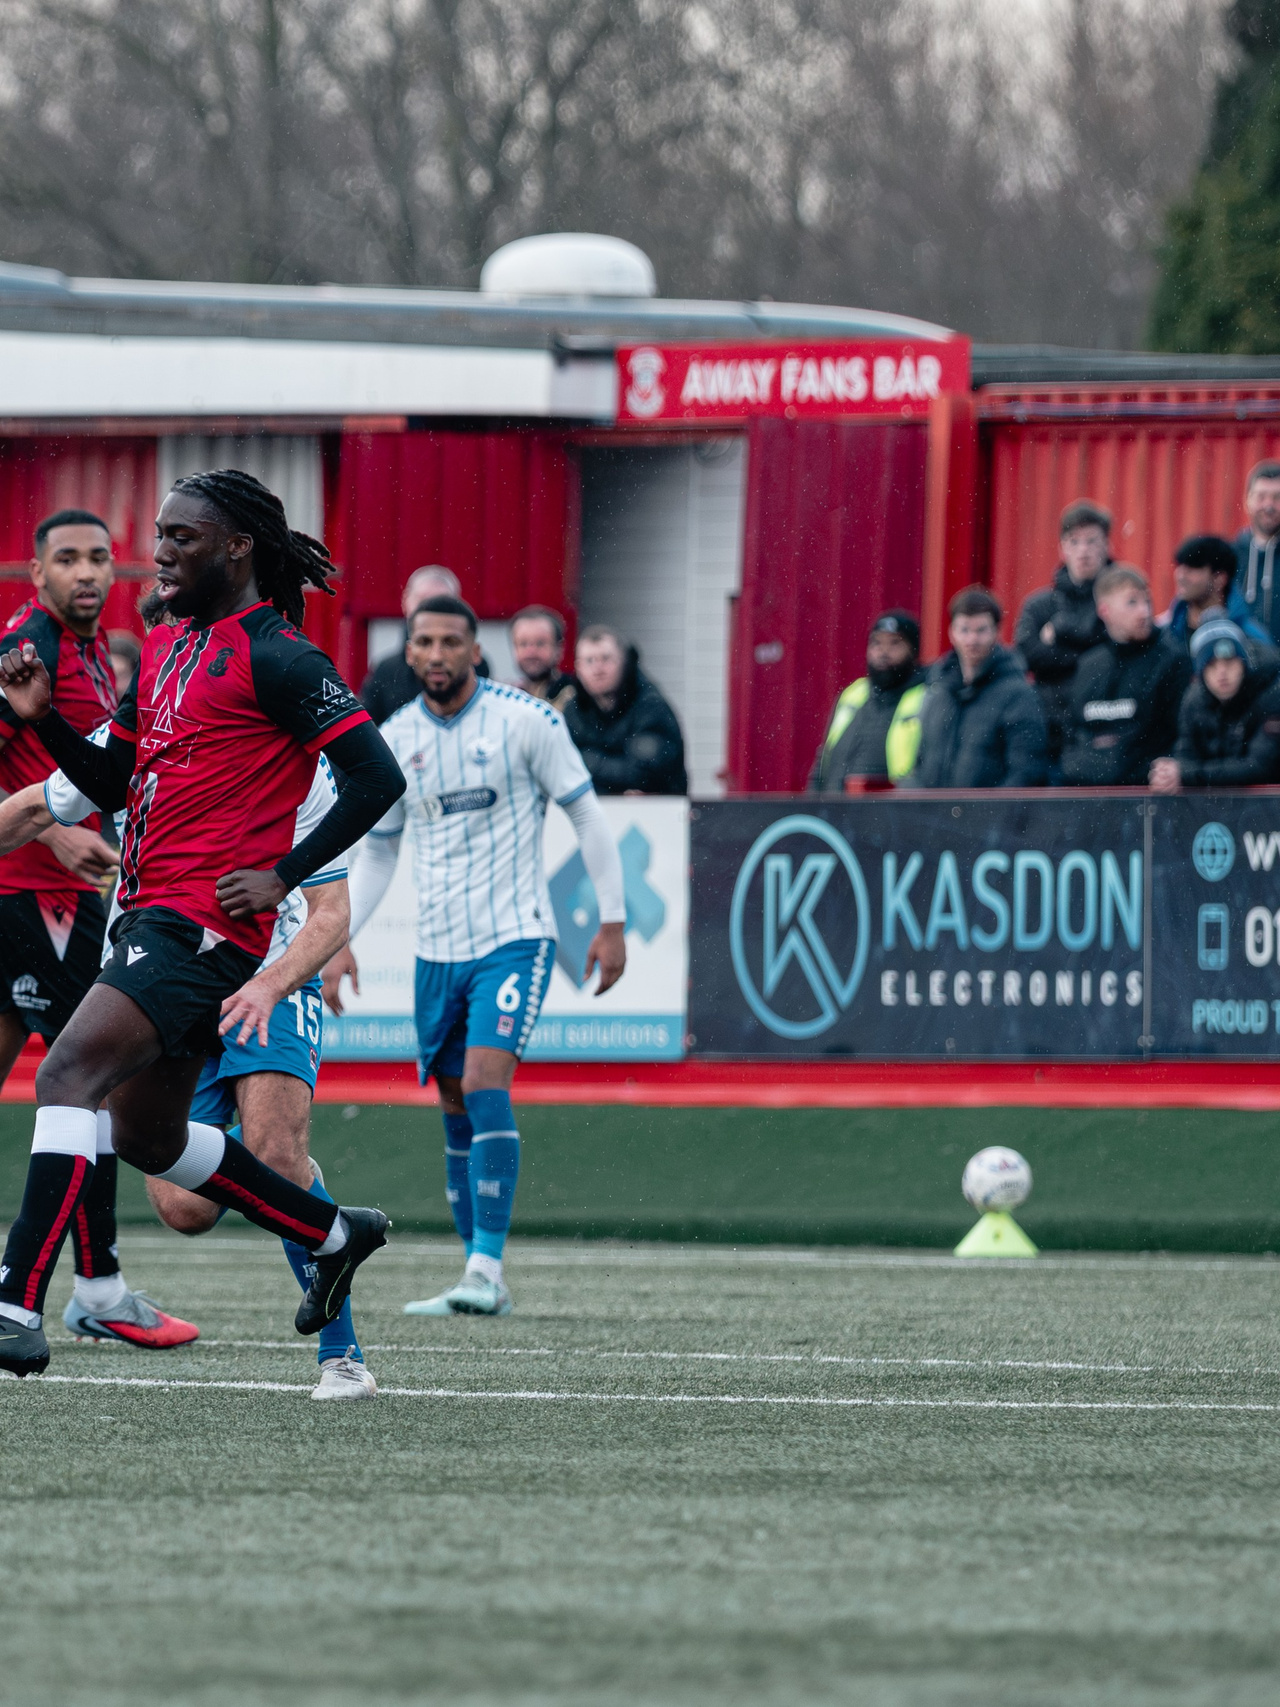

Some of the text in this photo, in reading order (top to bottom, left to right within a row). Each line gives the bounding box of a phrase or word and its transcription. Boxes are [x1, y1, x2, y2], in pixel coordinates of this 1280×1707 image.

[680, 354, 942, 404] AWAY FANS BAR
[882, 850, 1144, 952] KASDON
[496, 972, 521, 1013] 6
[880, 970, 1144, 1007] ELECTRONICS
[288, 990, 321, 1046] 15
[1192, 999, 1269, 1035] PROUD
